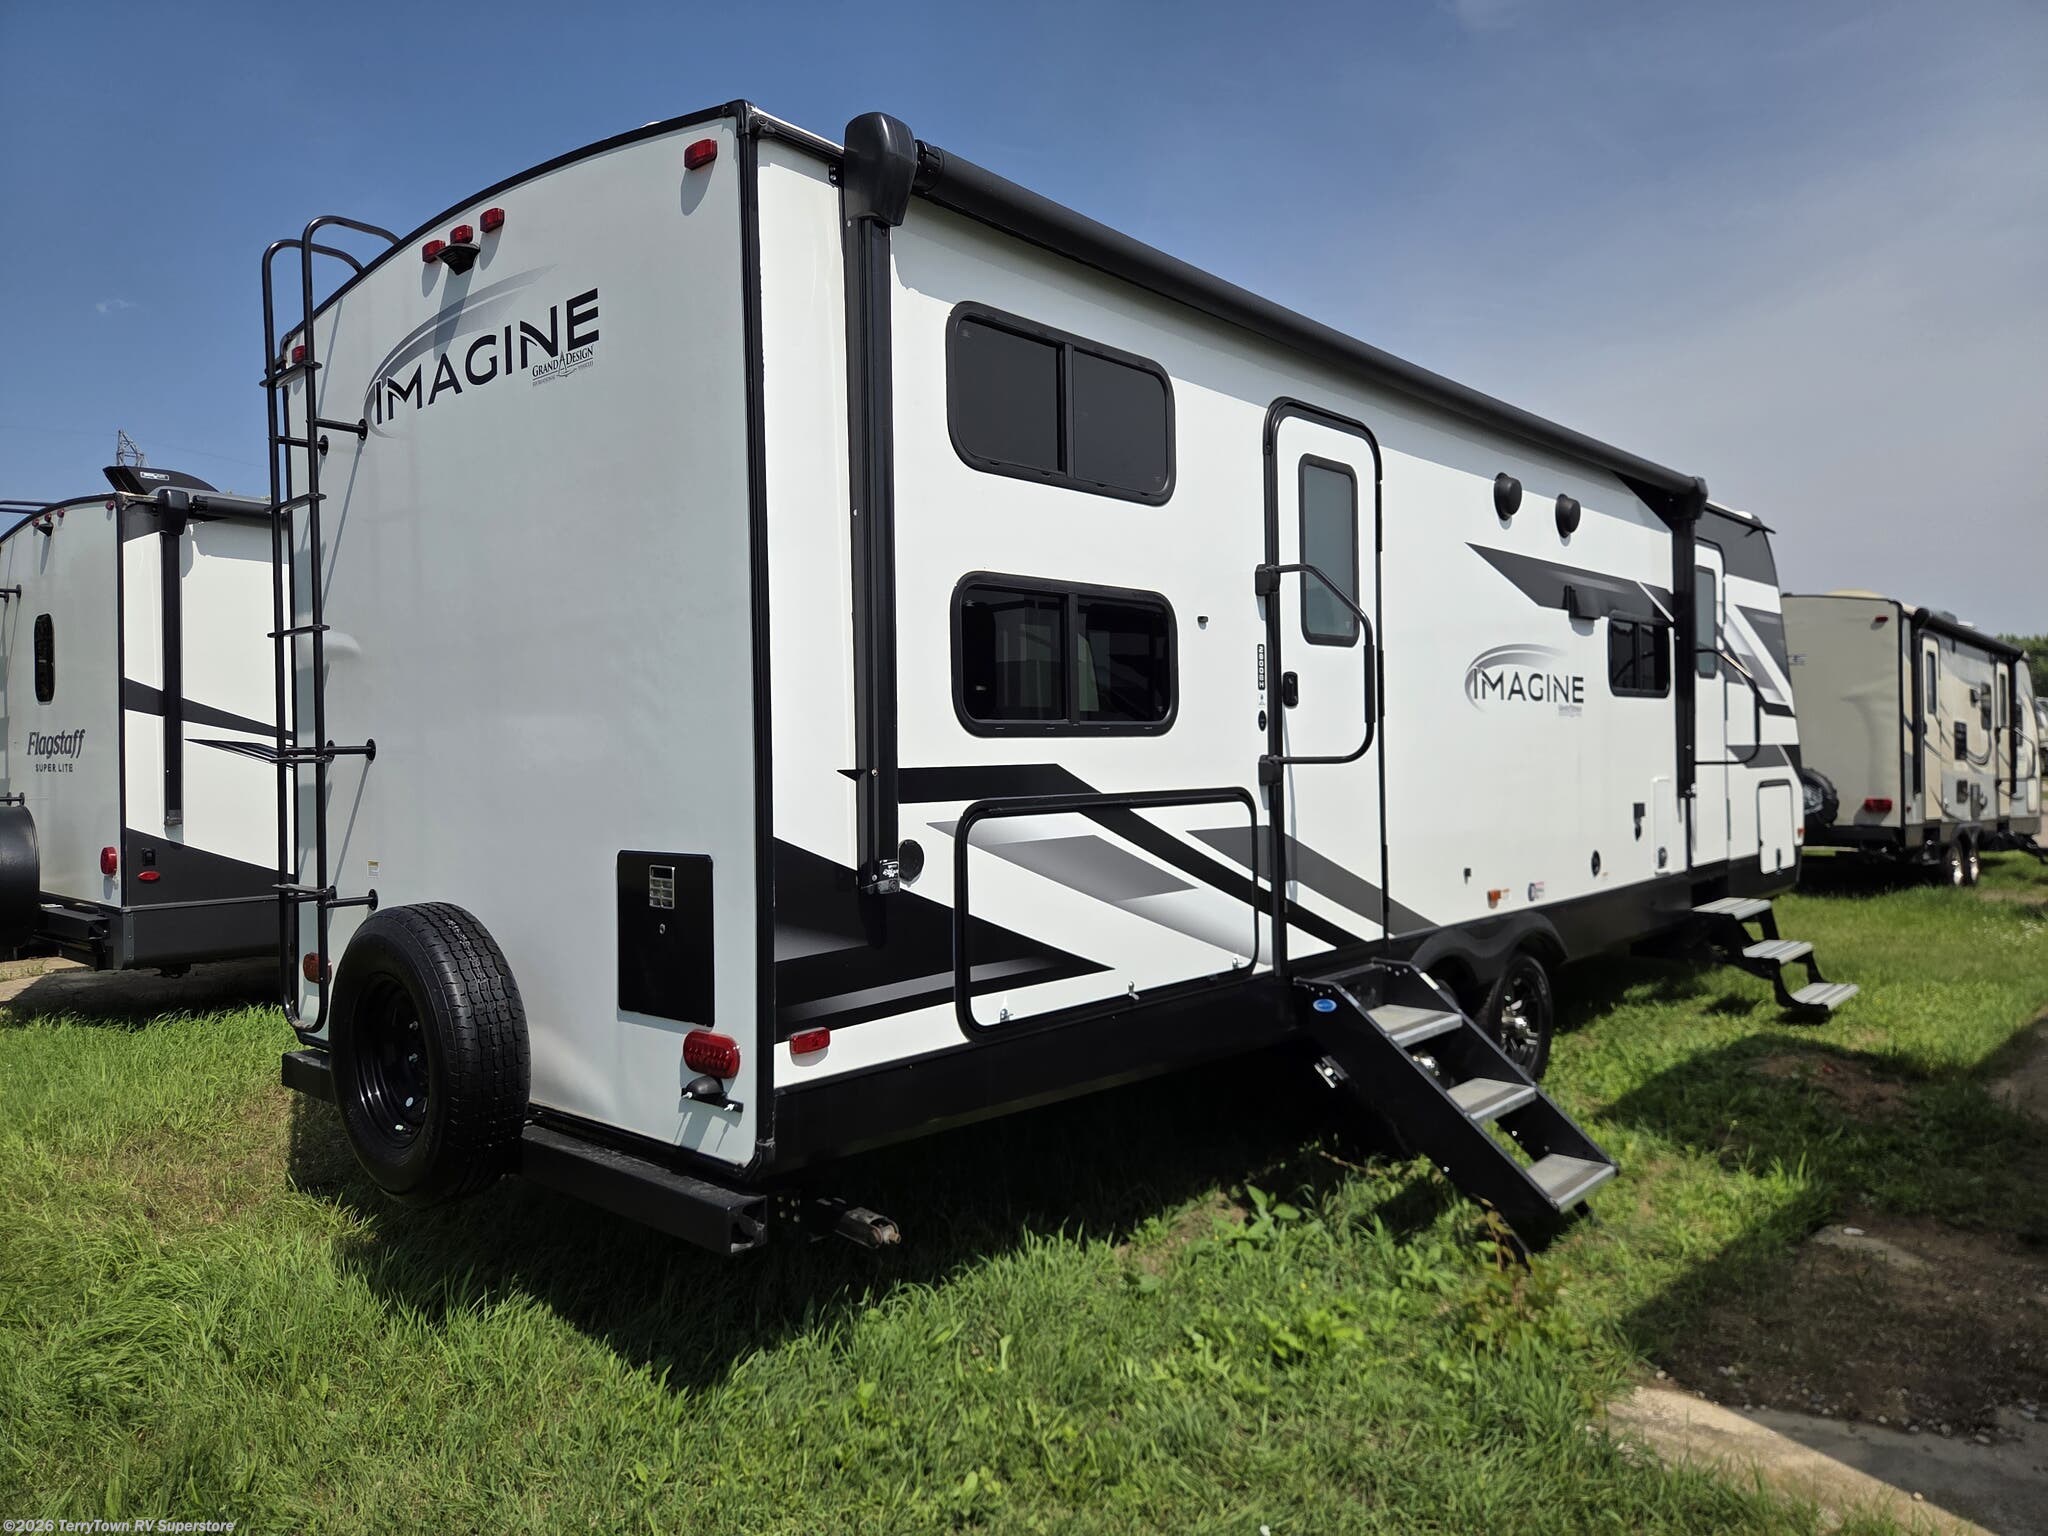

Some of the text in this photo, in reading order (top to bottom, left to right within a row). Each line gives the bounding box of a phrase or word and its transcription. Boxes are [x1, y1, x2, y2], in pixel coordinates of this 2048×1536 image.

[375, 288, 600, 425] IMAGINE
[532, 359, 559, 378] GRAND
[566, 345, 594, 366] DESIGN
[1473, 668, 1584, 704] IMAGINE
[26, 728, 86, 760] Flagstaff
[35, 763, 74, 773] SUPER LITE
